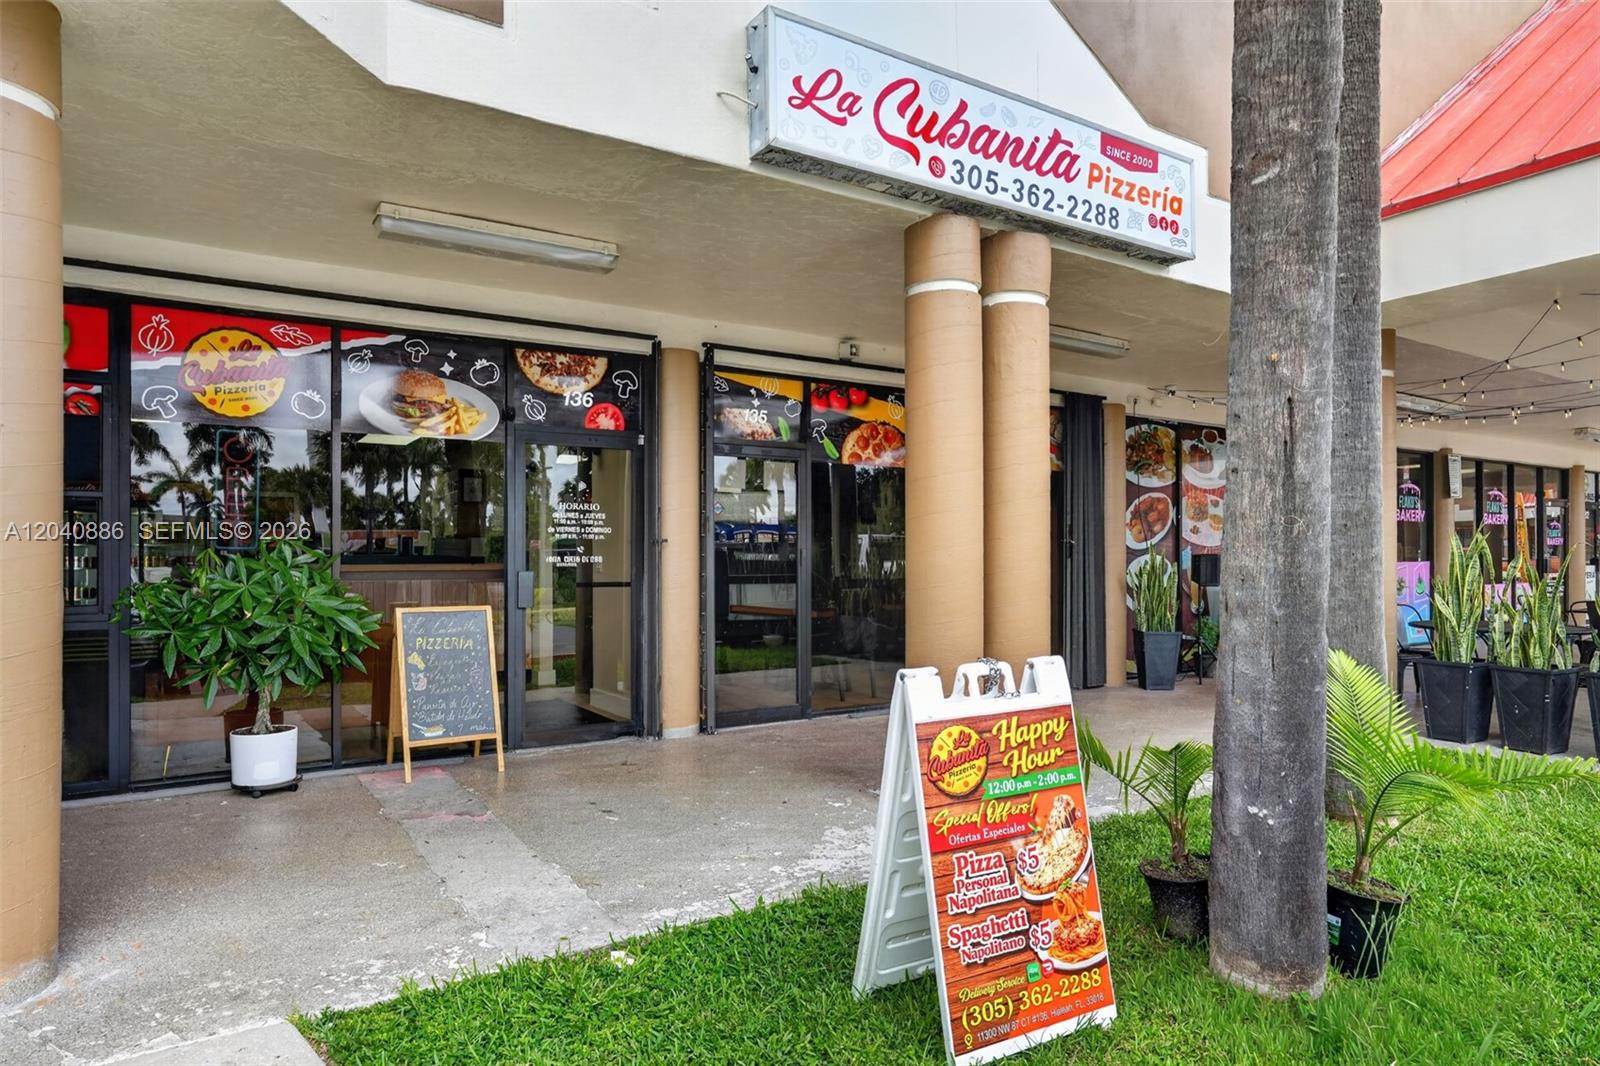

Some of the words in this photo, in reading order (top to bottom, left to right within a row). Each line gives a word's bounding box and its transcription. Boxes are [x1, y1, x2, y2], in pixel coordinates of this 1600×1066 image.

[788, 68, 863, 127] La
[873, 77, 1082, 184] Cubanita
[1106, 145, 1131, 161] SINCE
[1132, 154, 1154, 169] 2000
[950, 159, 1120, 230] 305-362-2288
[563, 391, 594, 408] 136
[743, 408, 768, 424] 135
[559, 502, 601, 511] HORARIO
[584, 512, 606, 520] JUEVES
[1396, 509, 1425, 523] BAKERY
[1484, 513, 1509, 525] BAKERY
[992, 715, 1070, 751] Happy
[1003, 744, 1065, 778] Hour
[987, 780, 1016, 795] 12:00
[1037, 772, 1060, 786] 2:00
[933, 802, 983, 836] Special
[986, 793, 1038, 824] Offers!
[949, 834, 981, 847] Ofertas
[983, 823, 1026, 840] Especiales
[954, 852, 1004, 877] Pizza
[1017, 846, 1040, 872] $5
[956, 871, 1009, 892] Personal
[947, 885, 1020, 913] Napolitana
[949, 909, 1028, 947] Spaghetti
[960, 937, 1025, 964] Napolitano
[1029, 920, 1053, 949] $5
[959, 985, 996, 1003] Delivery
[996, 976, 1025, 992] Service
[961, 995, 1014, 1033] (305)
[1019, 968, 1102, 1010] 362-2288
[976, 1028, 998, 1041] 11300
[998, 1023, 1011, 1037] NW
[1011, 1020, 1020, 1031] 87
[1020, 1017, 1031, 1027] CT
